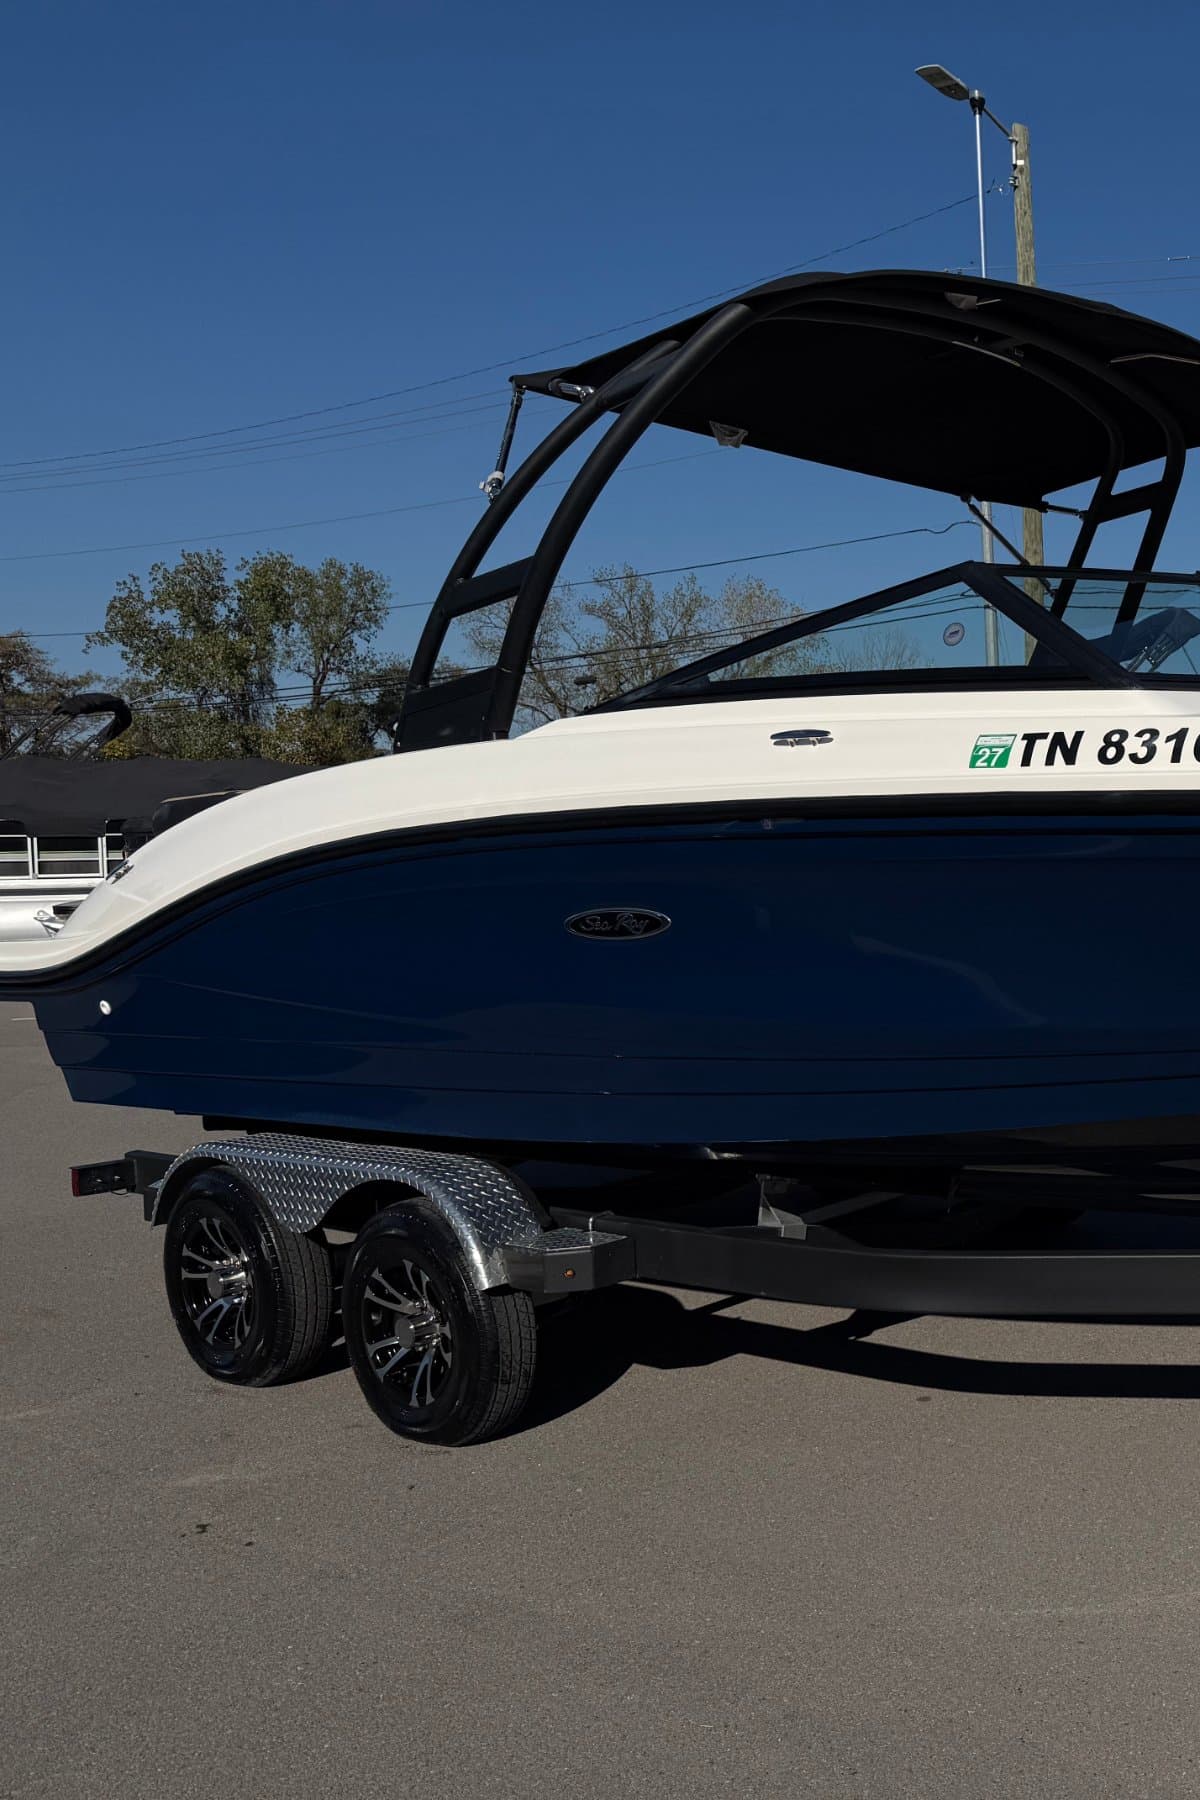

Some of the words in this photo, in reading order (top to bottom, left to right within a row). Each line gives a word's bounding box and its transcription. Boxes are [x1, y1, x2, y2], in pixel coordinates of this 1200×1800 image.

[975, 747, 1005, 767] 27
[1020, 730, 1085, 768] TN
[581, 915, 612, 931] Sea
[614, 912, 649, 935] Ray
